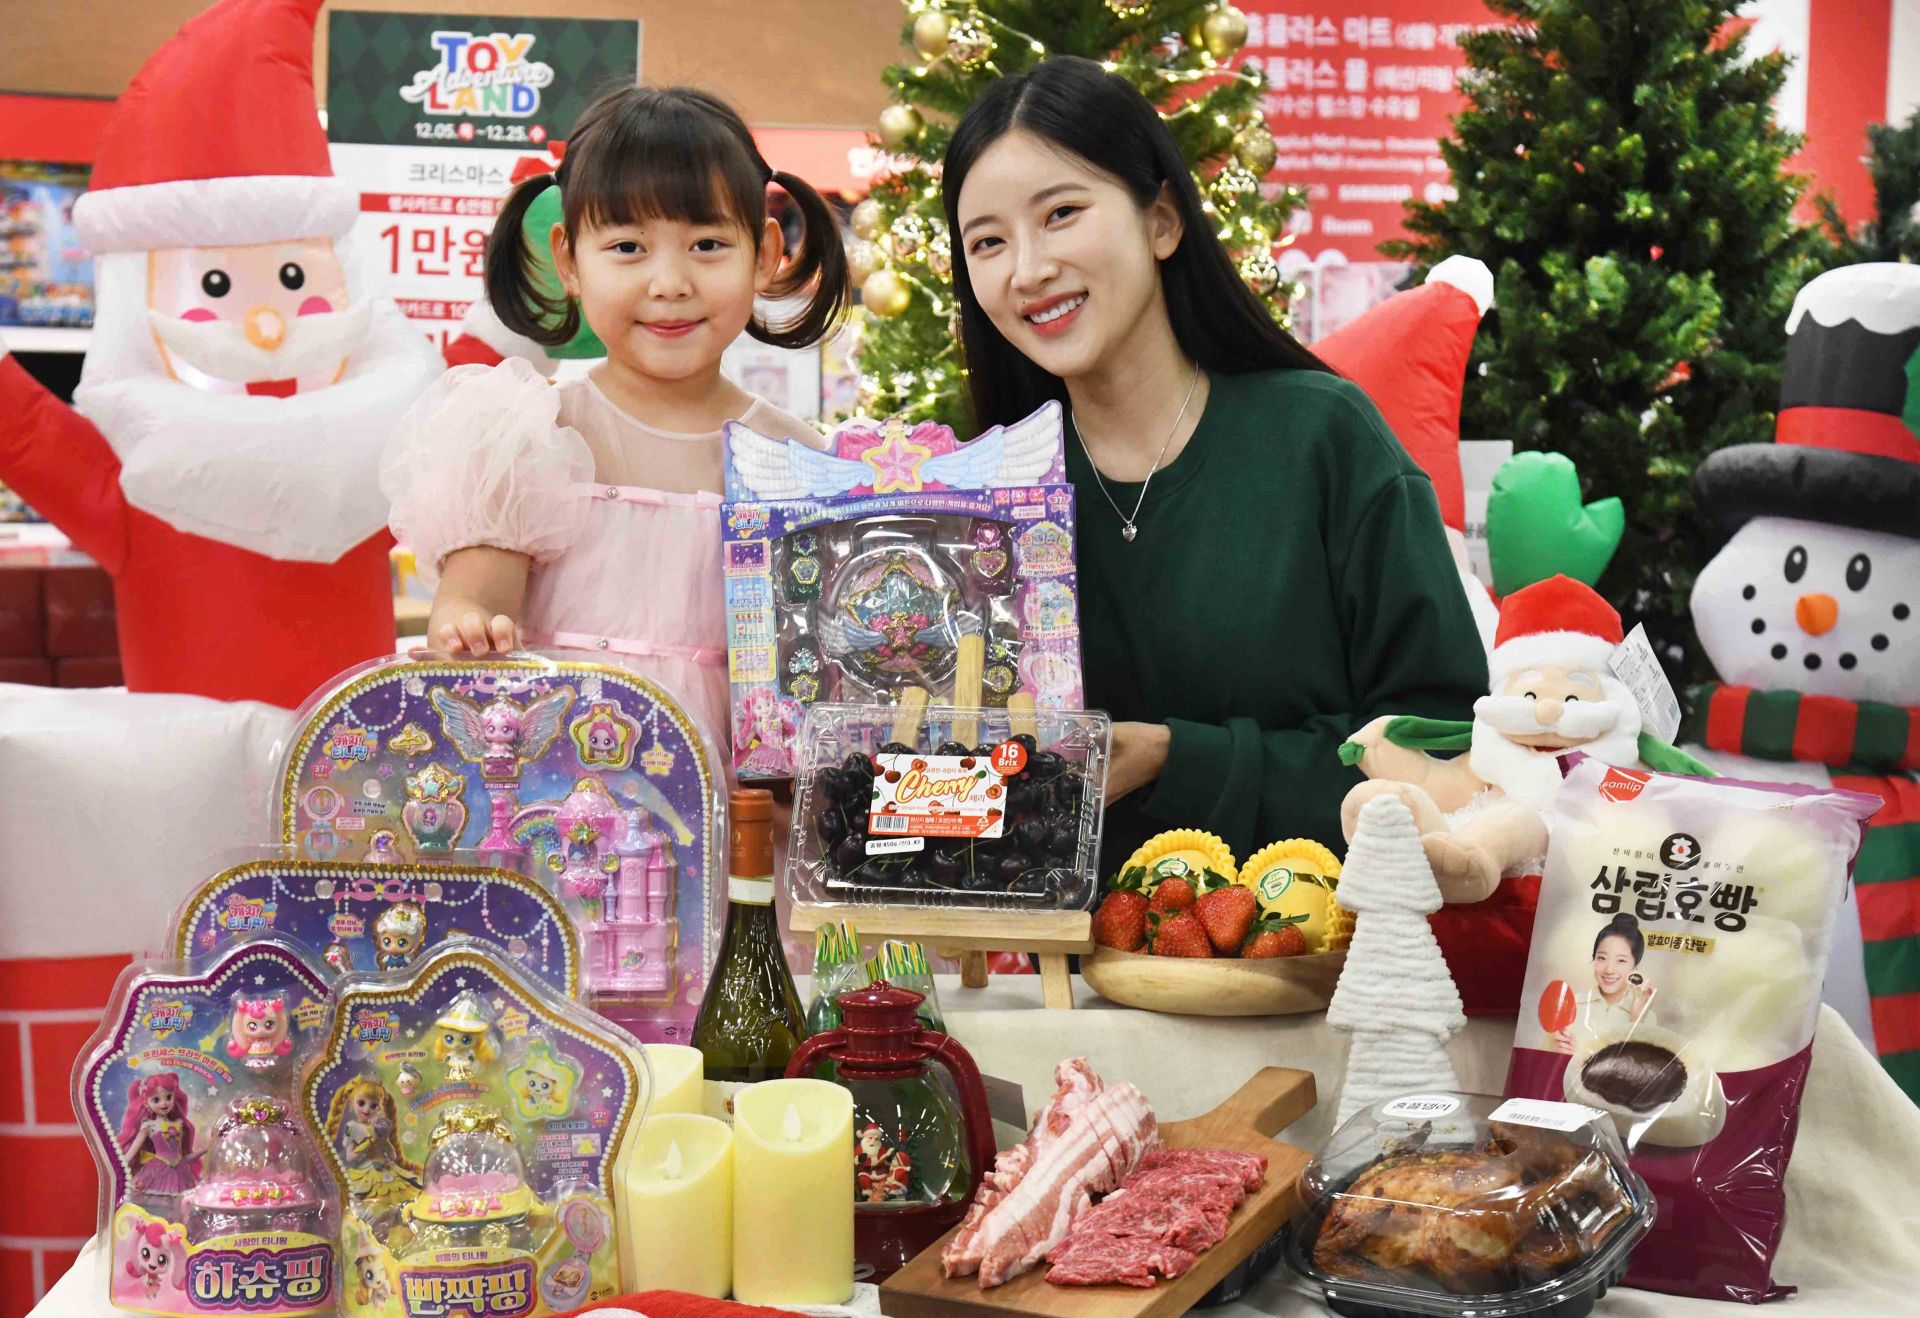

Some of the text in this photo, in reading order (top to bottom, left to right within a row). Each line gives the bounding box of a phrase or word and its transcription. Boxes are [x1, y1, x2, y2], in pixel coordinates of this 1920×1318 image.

[437, 35, 530, 74] TOY
[428, 82, 535, 113] LAND
[408, 163, 504, 185] 크리스마스
[332, 734, 364, 747] 캐치!
[331, 745, 368, 761] 티니핑
[1000, 744, 1019, 758] 16
[998, 757, 1018, 767] Brix
[895, 769, 979, 803] Cherry
[1602, 780, 1642, 793] samlip
[1590, 864, 1759, 933] 삼립호빵
[150, 1016, 184, 1032] 티니핑
[358, 1027, 392, 1043] 티니핑
[195, 1255, 324, 1299] 하츄핑
[404, 1268, 527, 1315] 빤짝핑
